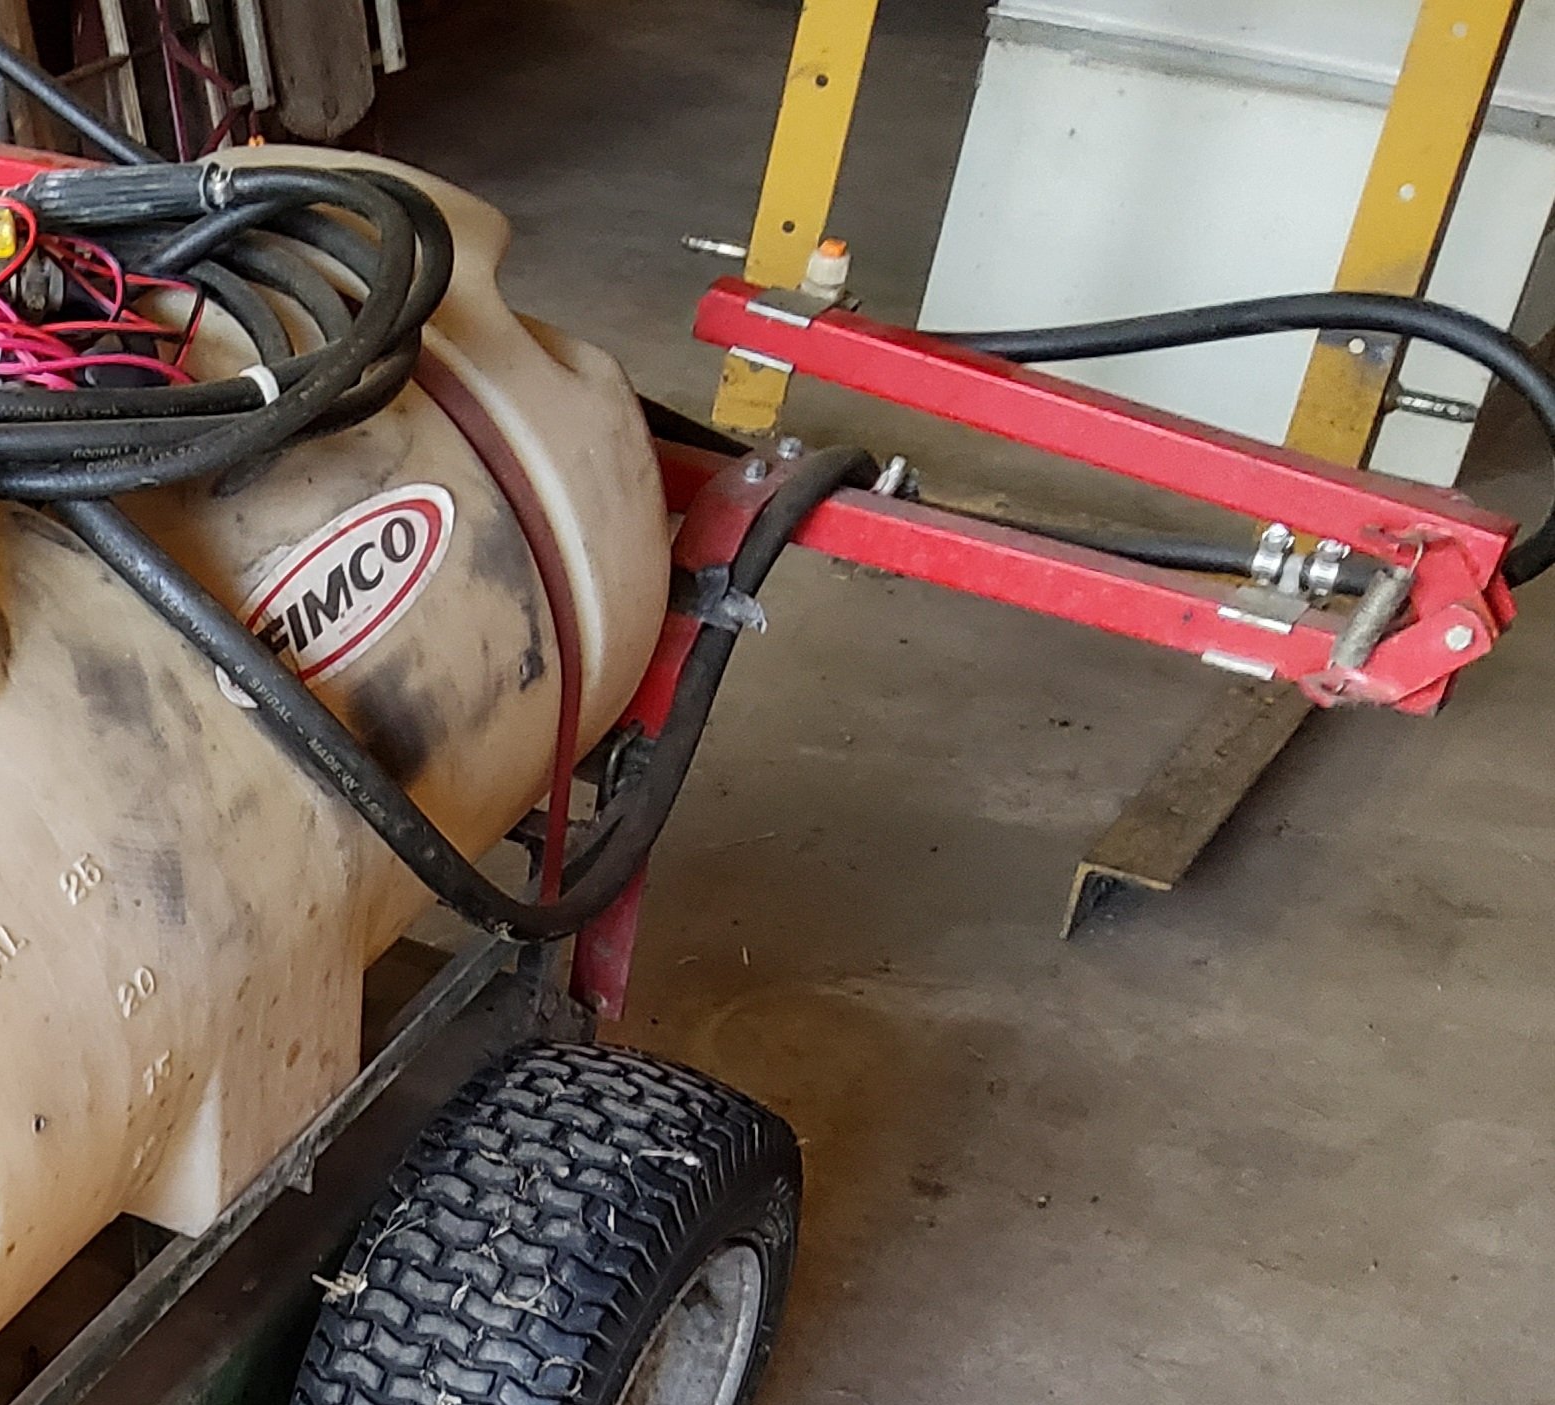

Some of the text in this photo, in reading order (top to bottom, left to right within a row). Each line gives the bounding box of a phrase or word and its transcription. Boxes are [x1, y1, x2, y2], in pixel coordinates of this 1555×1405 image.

[248, 677, 293, 723] SPIRAL
[59, 852, 103, 906] 25
[118, 965, 157, 1019] 20
